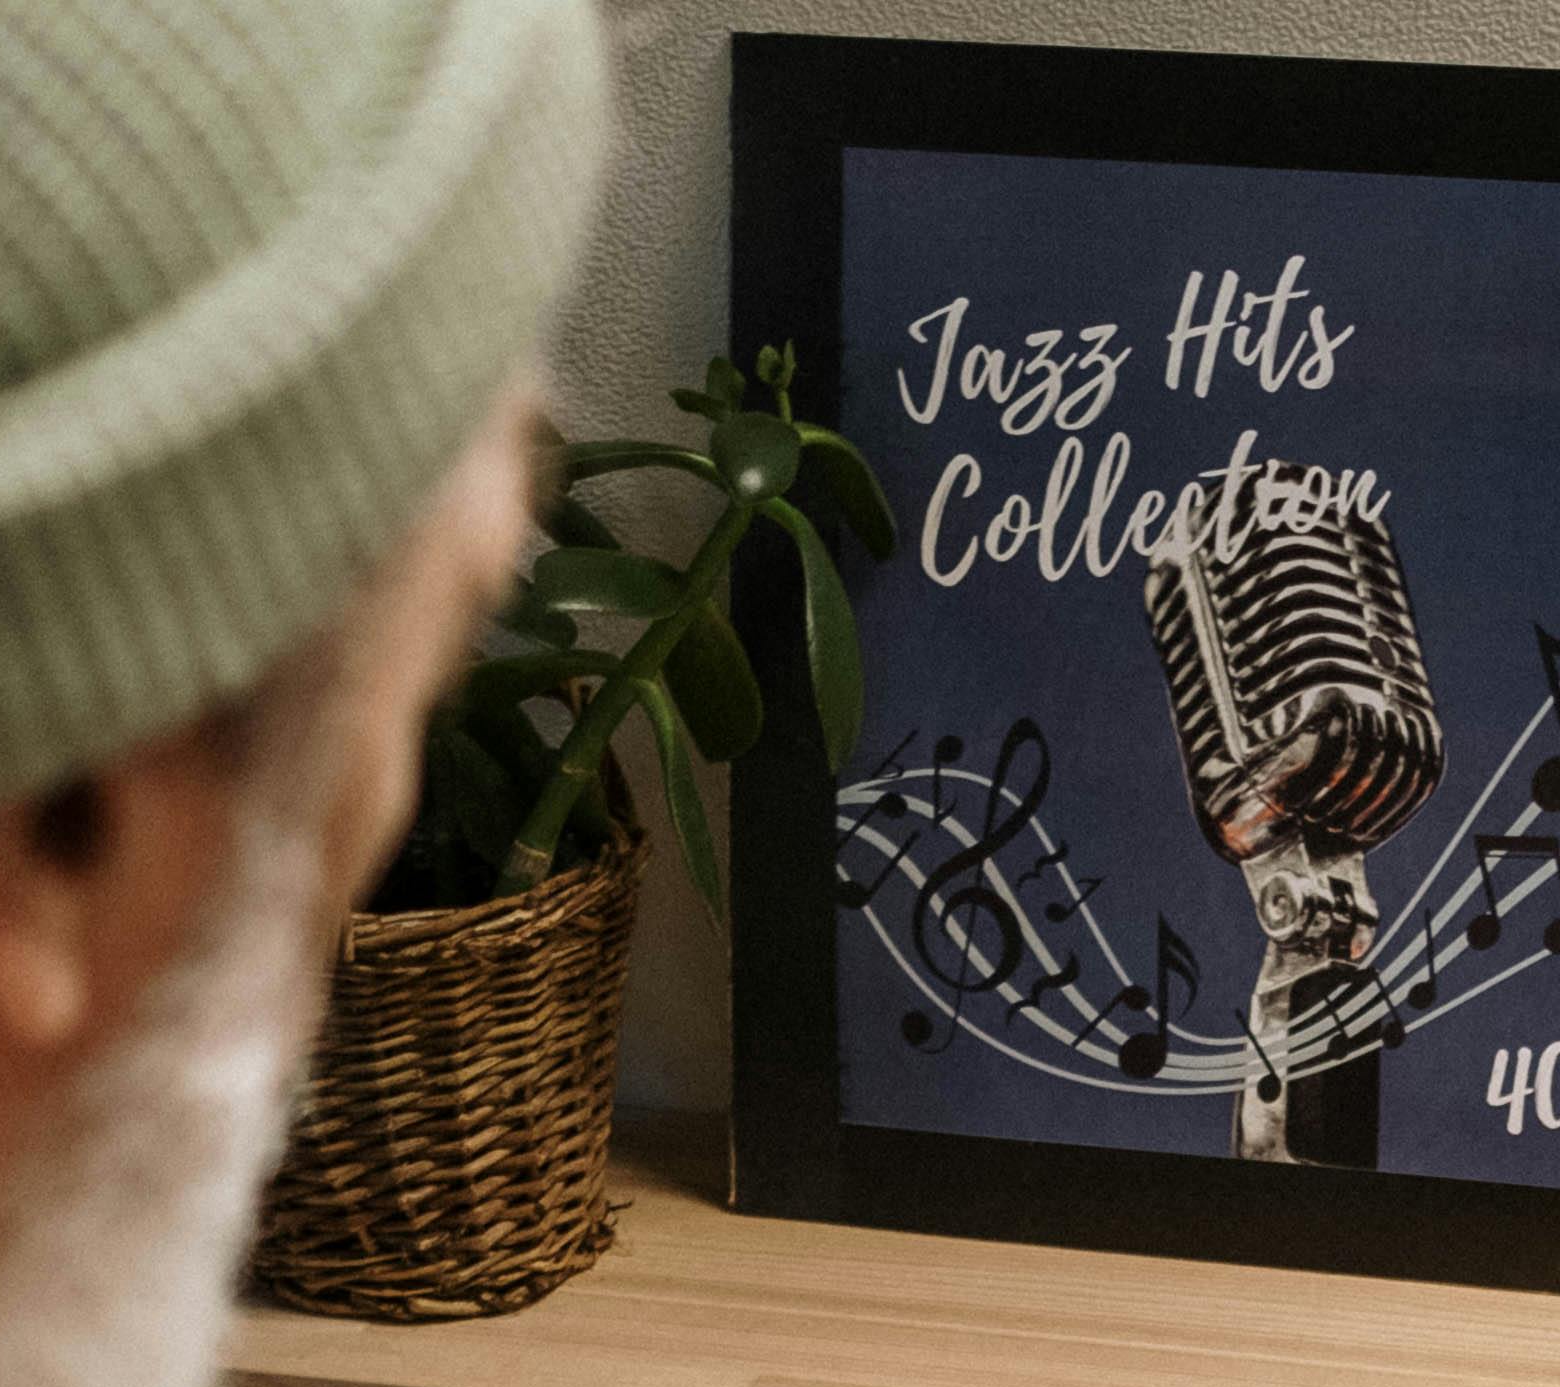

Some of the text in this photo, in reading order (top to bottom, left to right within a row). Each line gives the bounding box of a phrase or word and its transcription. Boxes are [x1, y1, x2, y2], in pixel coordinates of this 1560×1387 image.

[897, 254, 1355, 436] Jazz Hits
[921, 428, 1392, 588] Collection
